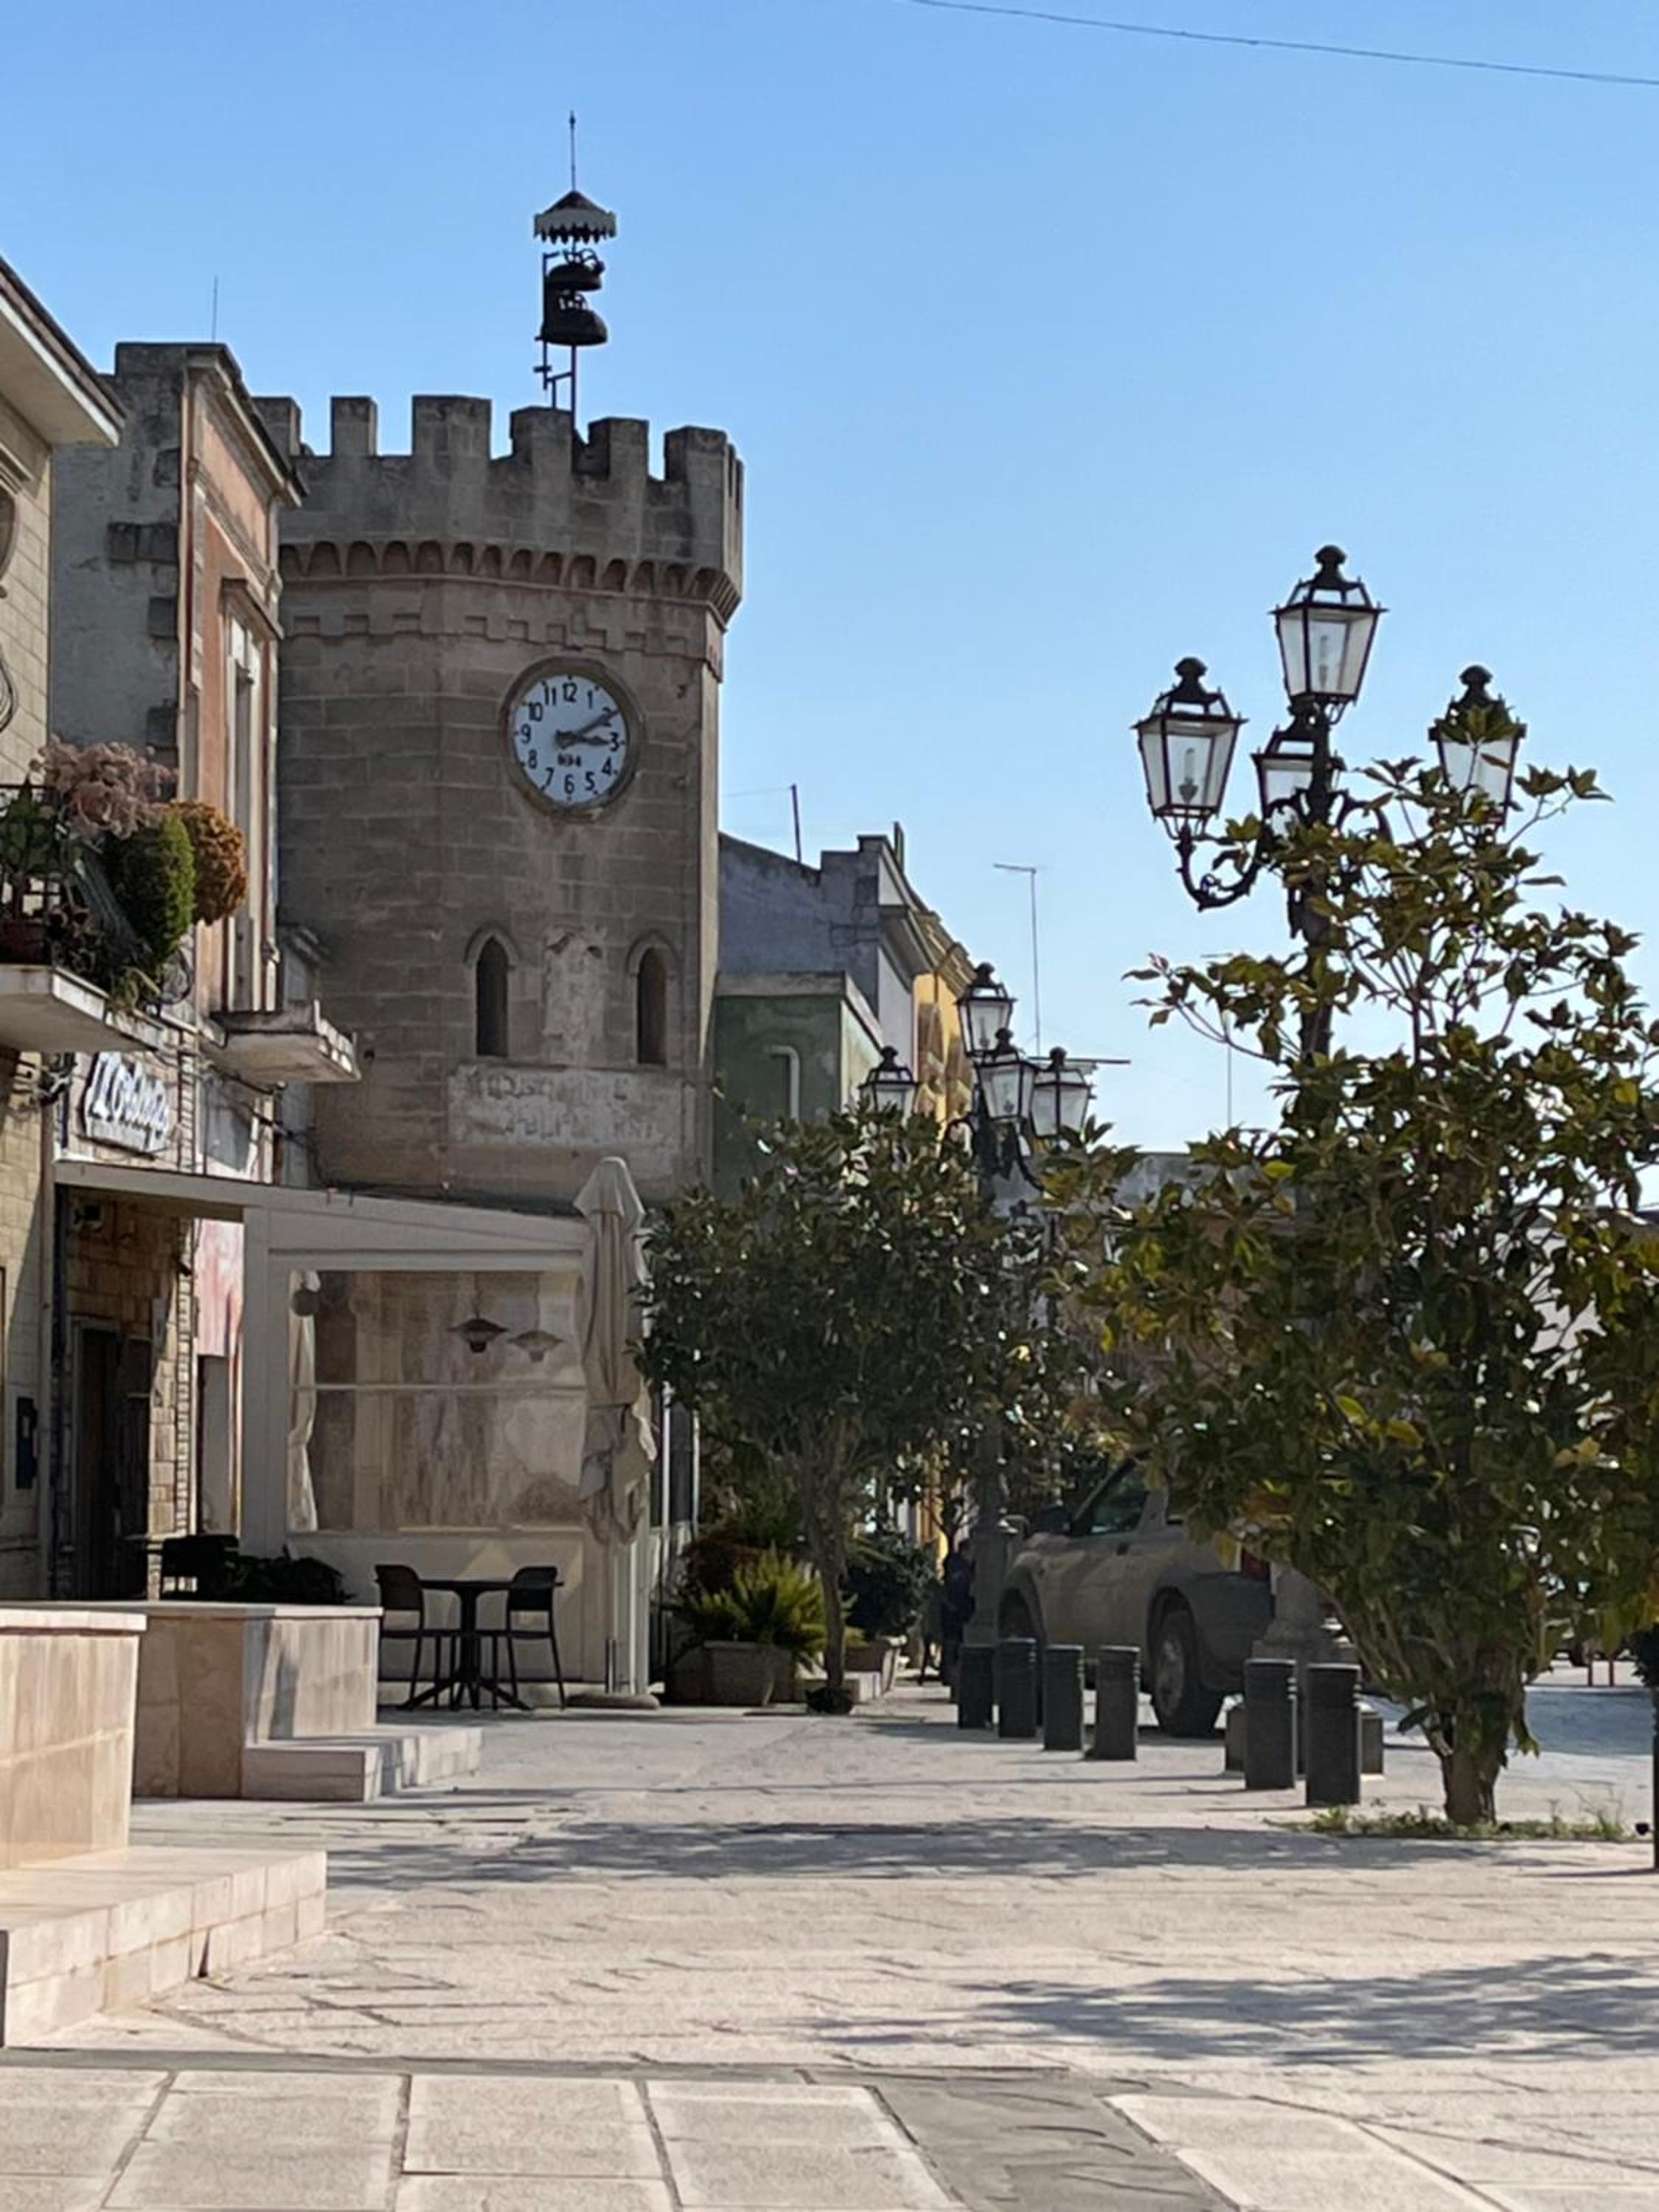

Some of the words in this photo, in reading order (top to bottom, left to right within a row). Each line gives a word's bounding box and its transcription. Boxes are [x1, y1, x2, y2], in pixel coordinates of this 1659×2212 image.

[544, 686, 557, 706] 11
[563, 682, 577, 702] 12
[588, 690, 593, 709] 1
[529, 702, 543, 721] 10
[602, 706, 612, 727] 2
[521, 723, 532, 743] 9
[610, 732, 620, 752] 3
[528, 748, 538, 769] 8
[601, 757, 612, 776] 4
[546, 767, 554, 786] 7
[564, 774, 574, 794] 6
[585, 771, 595, 790] 5
